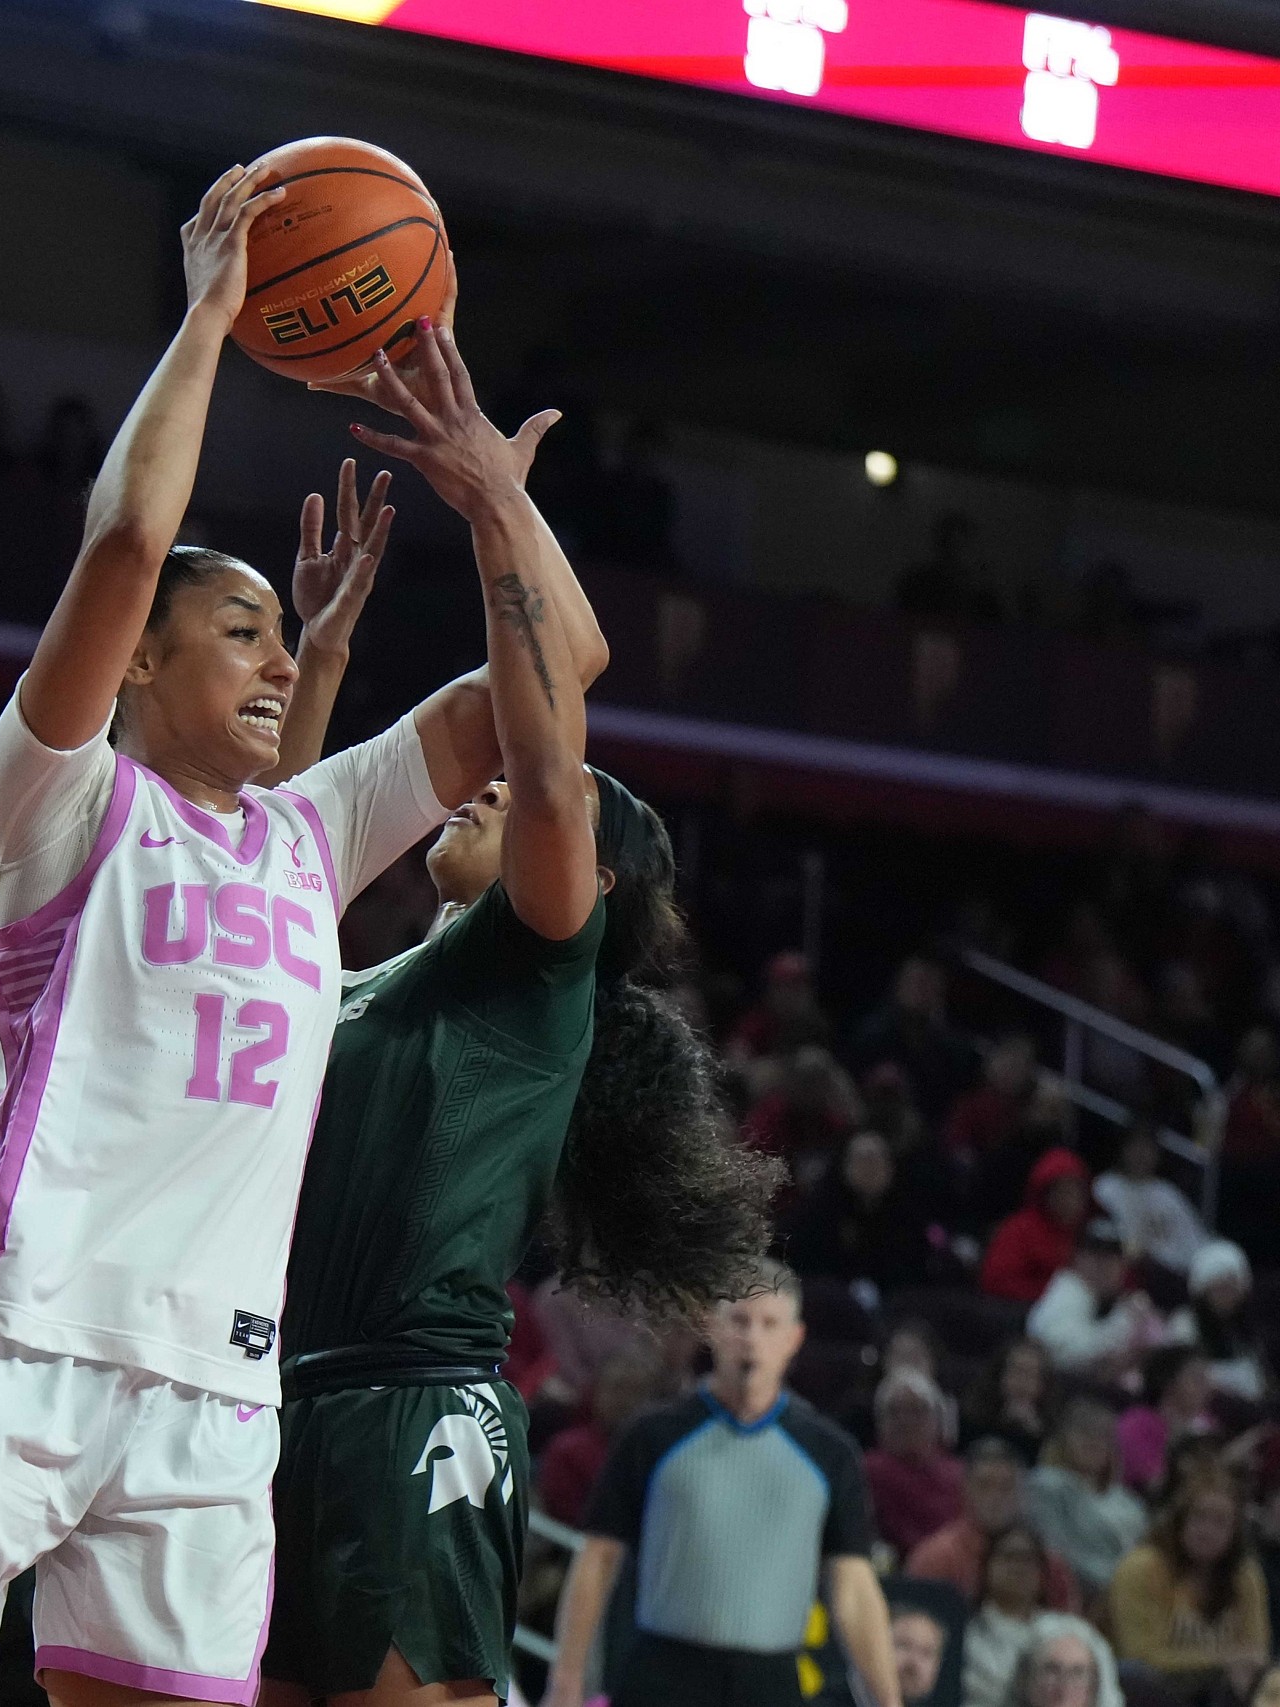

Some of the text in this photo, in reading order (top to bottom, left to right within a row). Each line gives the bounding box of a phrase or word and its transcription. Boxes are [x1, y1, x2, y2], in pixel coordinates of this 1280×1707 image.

[259, 253, 380, 314] CHAMPIONSHIP
[262, 264, 397, 345] ELITE
[142, 881, 321, 994] USC
[184, 992, 291, 1110] 12
